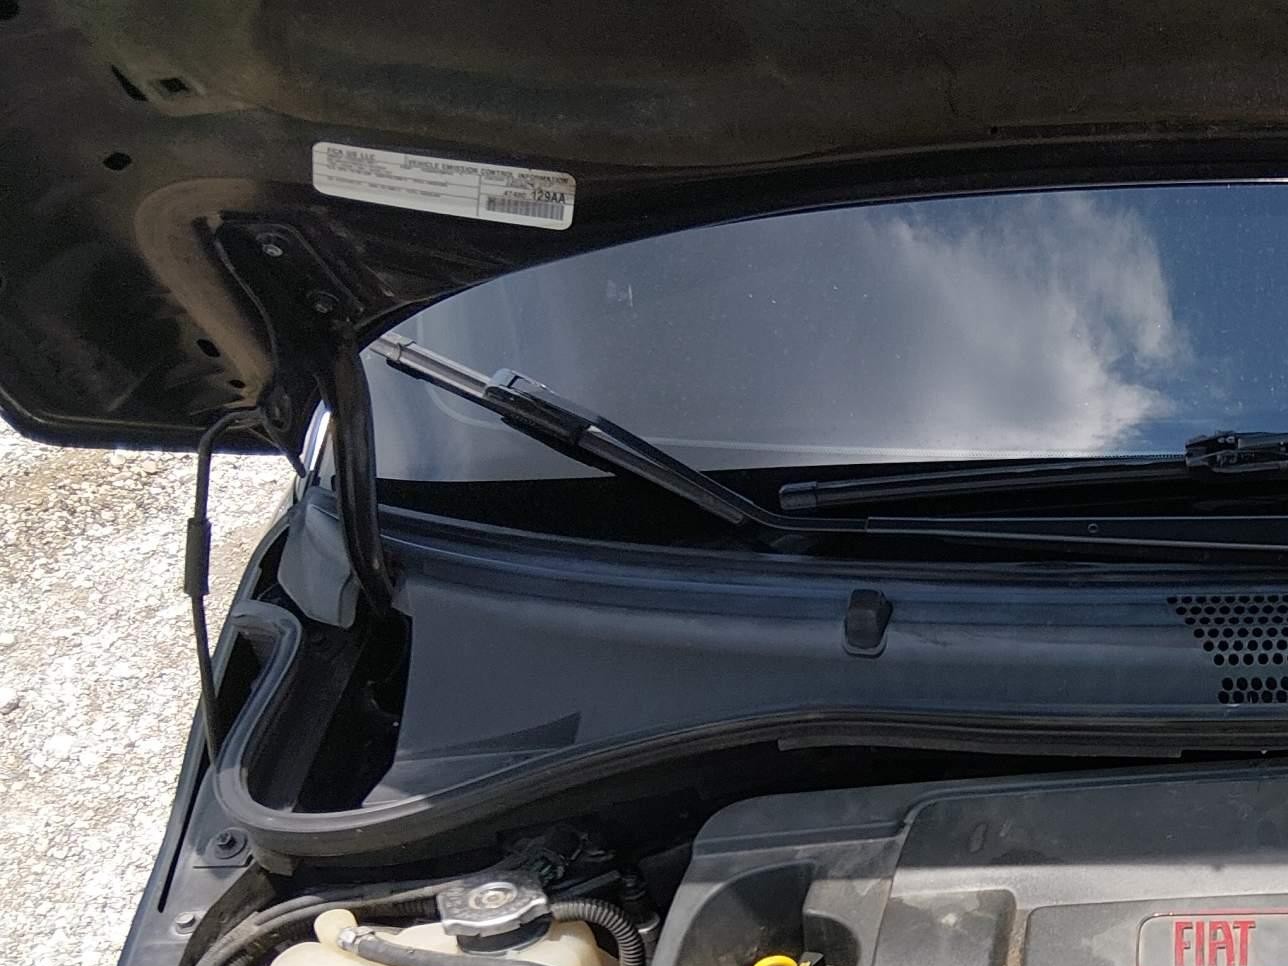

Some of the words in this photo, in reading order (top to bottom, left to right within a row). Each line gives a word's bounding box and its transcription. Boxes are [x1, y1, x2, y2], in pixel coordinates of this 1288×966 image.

[408, 159, 439, 170] VEHICLE
[442, 164, 479, 174] EMISSION
[481, 168, 513, 177] CONTROL
[518, 172, 571, 184] INFORMATION
[531, 191, 567, 205] 129AA
